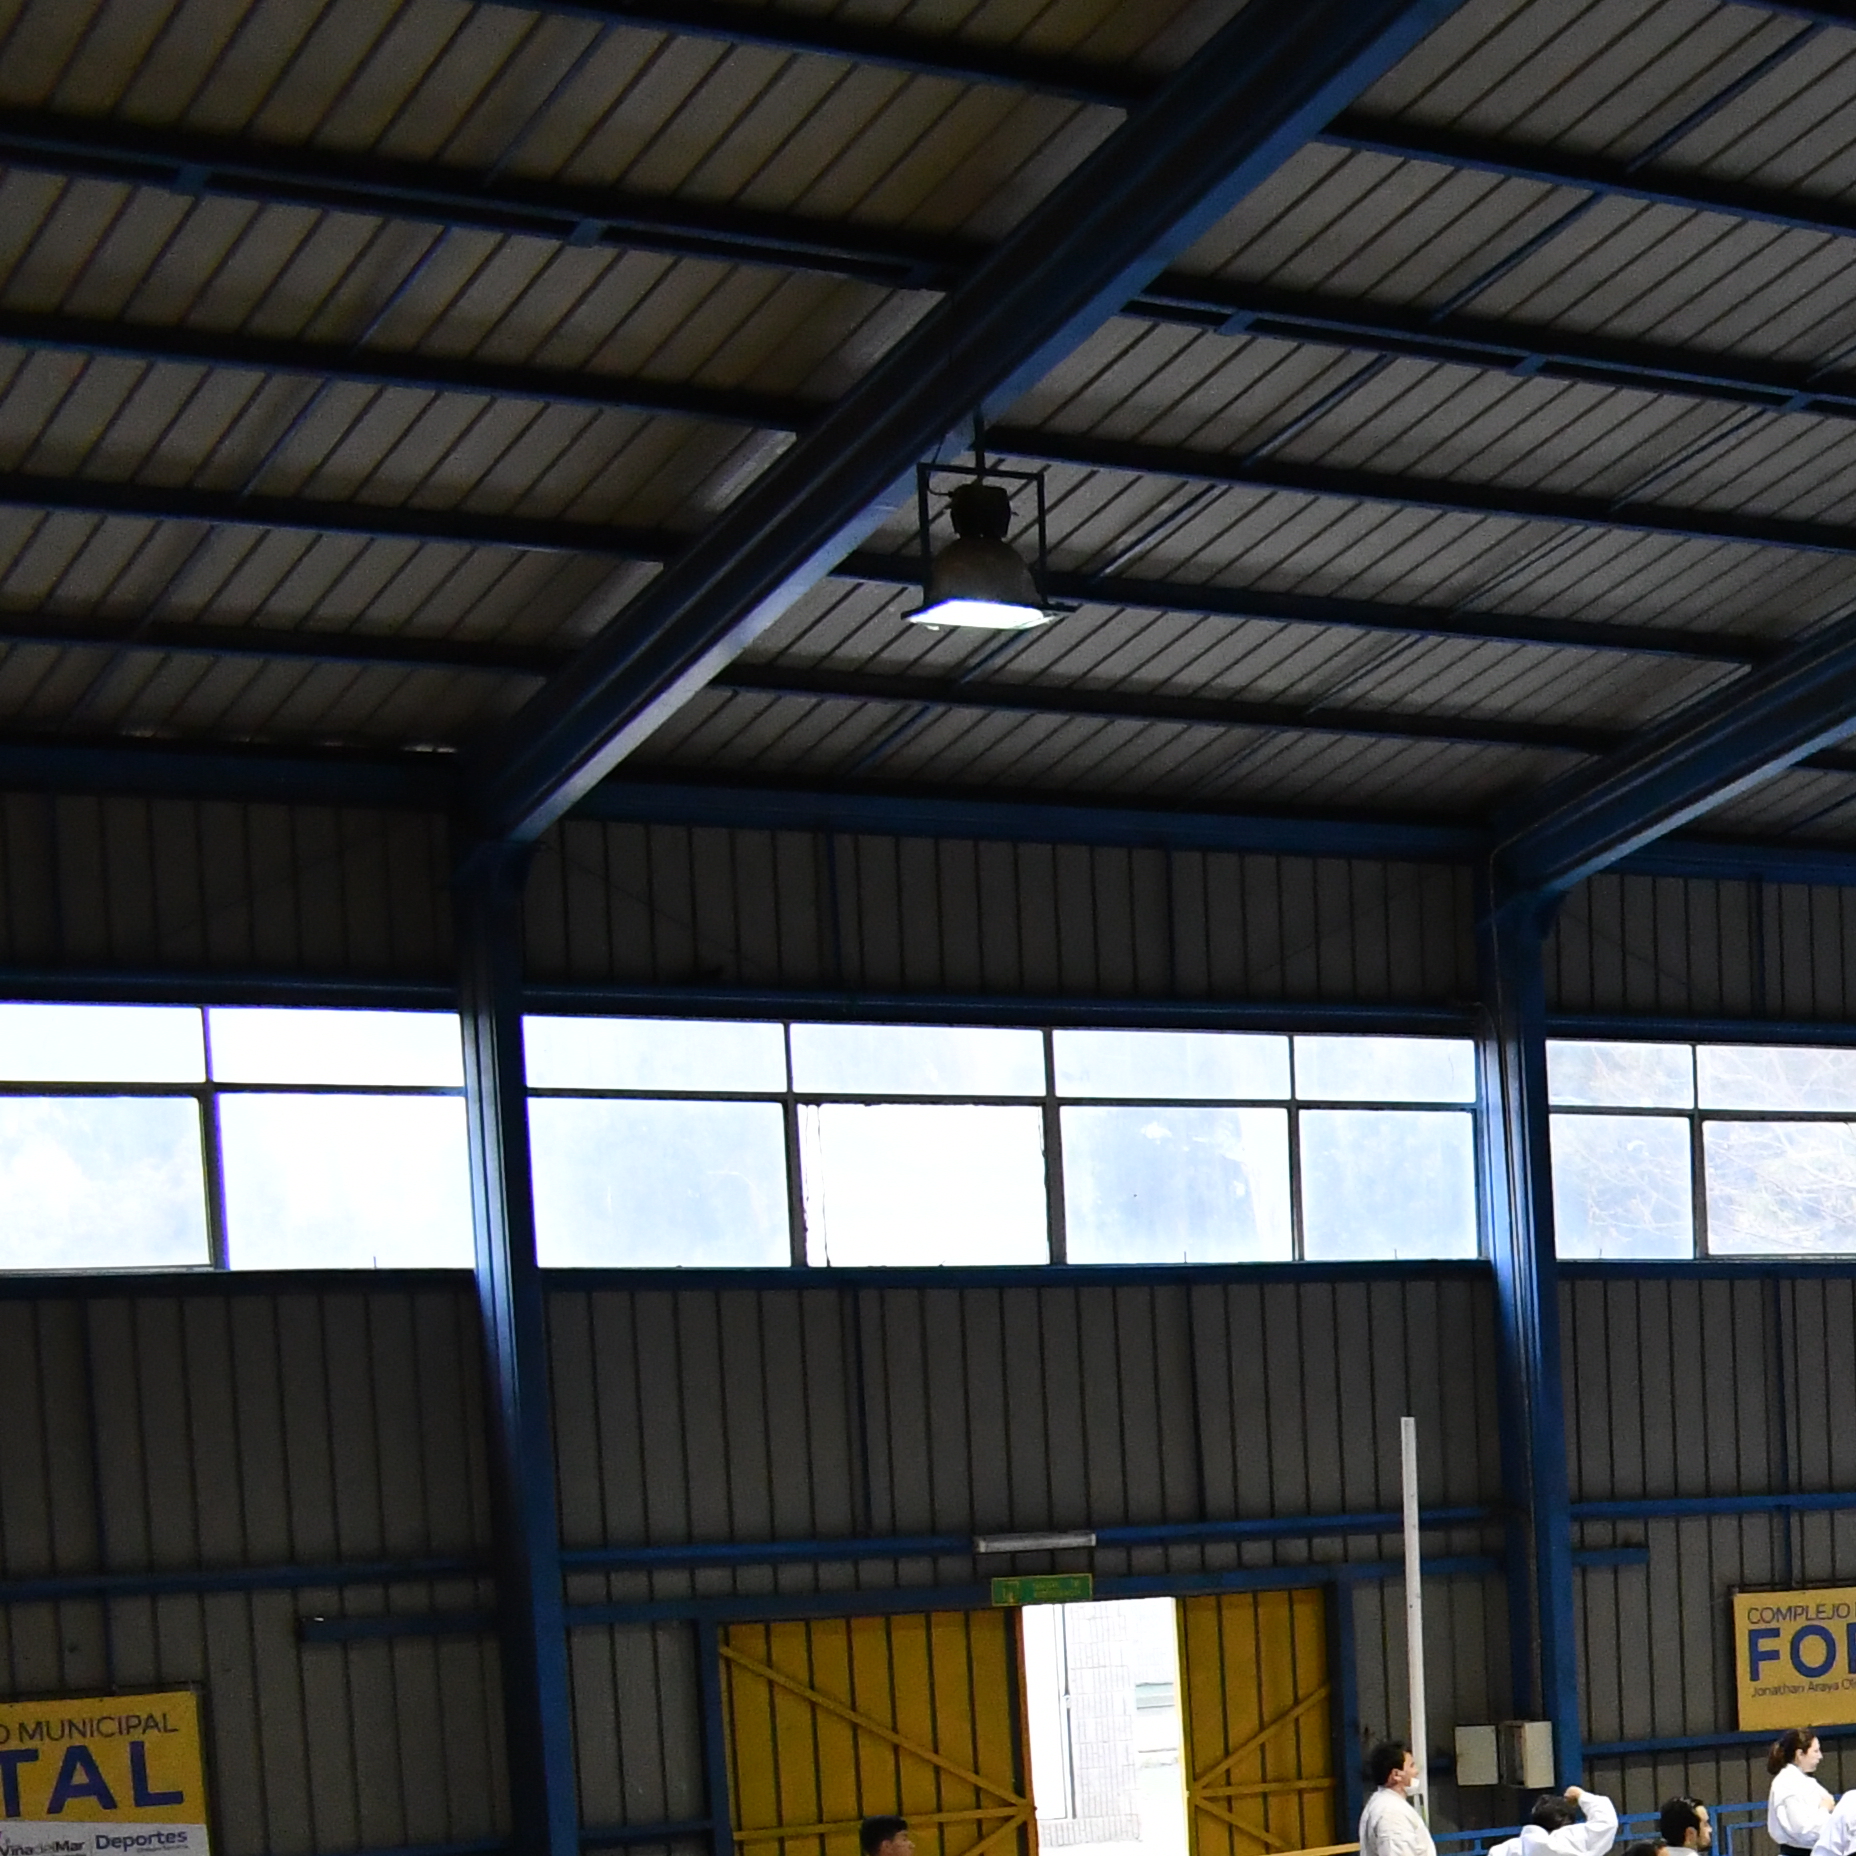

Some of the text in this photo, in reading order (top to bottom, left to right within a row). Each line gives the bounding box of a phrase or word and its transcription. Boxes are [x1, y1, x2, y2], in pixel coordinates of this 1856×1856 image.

[1747, 1602, 1850, 1625] COMPLEJO
[1750, 1681, 1805, 1698] Jonathan
[1807, 1679, 1839, 1694] Araya
[18, 1713, 179, 1743] MUNICIPAL
[0, 1740, 185, 1818] TAL
[95, 1830, 188, 1852] Deportes
